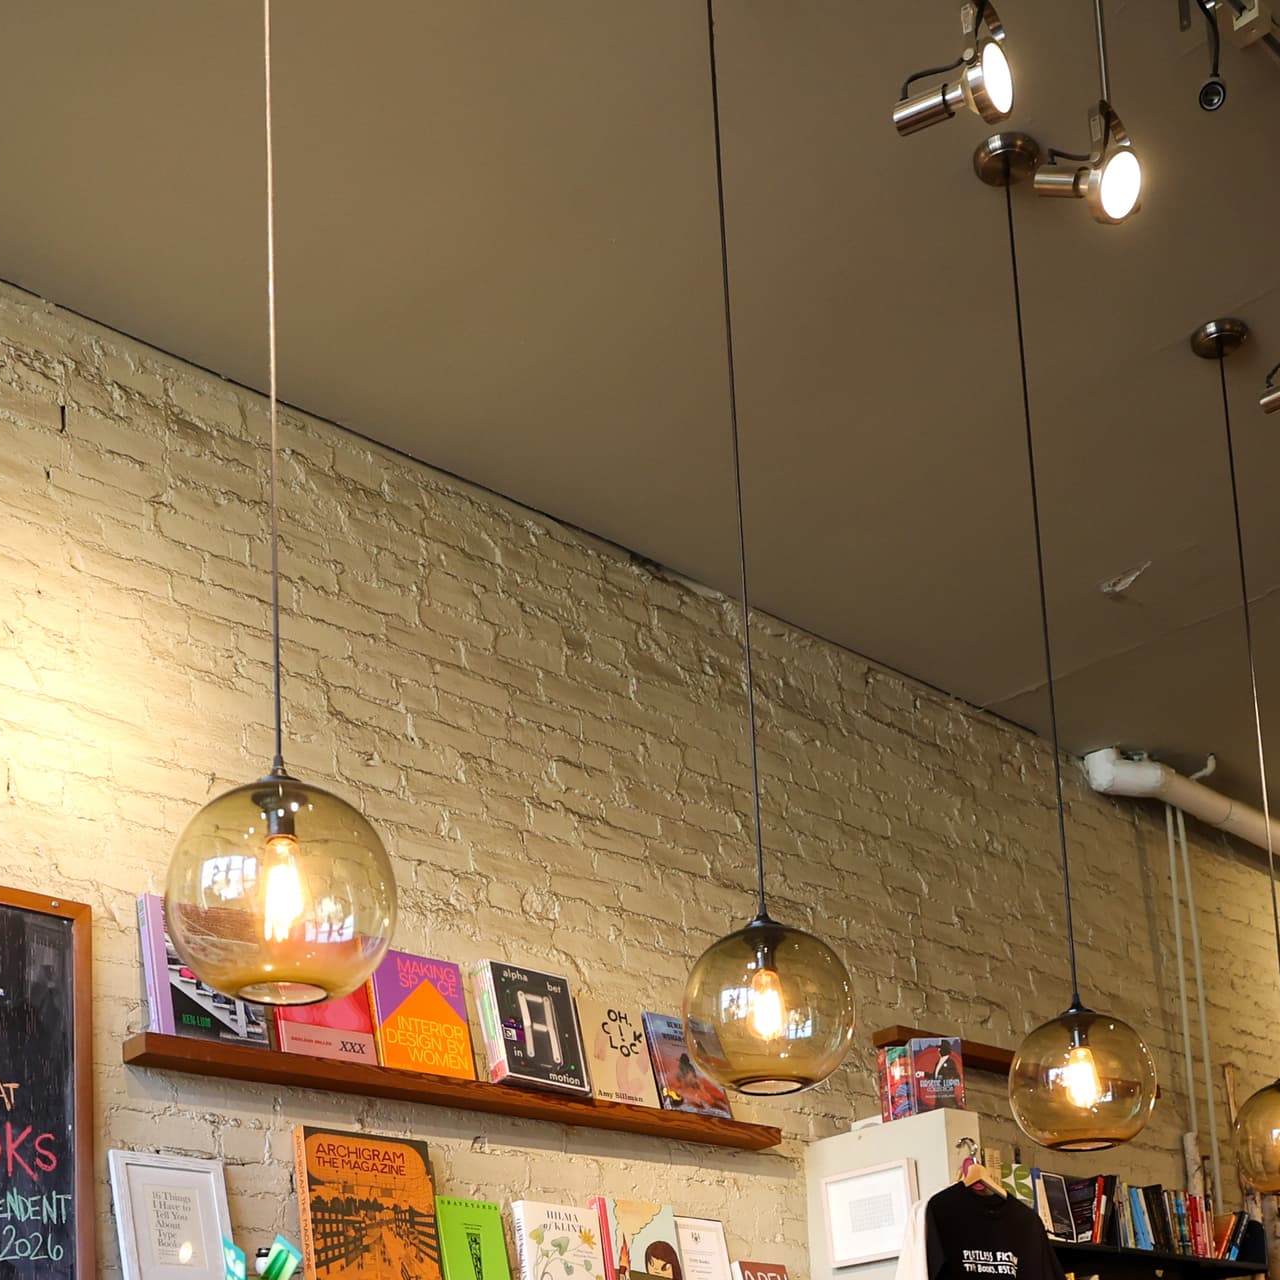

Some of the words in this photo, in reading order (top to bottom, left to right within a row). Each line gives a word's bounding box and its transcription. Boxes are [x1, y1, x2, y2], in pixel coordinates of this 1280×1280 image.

[396, 956, 457, 984] MAKING
[502, 968, 529, 984] alpha
[546, 982, 562, 994] bet
[397, 1014, 464, 1039] INTERIOR
[338, 1039, 367, 1054] XXX
[386, 1028, 443, 1051] DESIGN
[447, 1039, 466, 1056] BY
[408, 1045, 469, 1071] WOMEN
[513, 1046, 524, 1058] in
[549, 1072, 581, 1086] motion
[315, 1142, 406, 1165] ARCHIGRAM
[315, 1155, 340, 1169] THE
[341, 1158, 407, 1177] MAGAZINE
[162, 1191, 192, 1203] Things
[545, 1209, 579, 1223] HILMA
